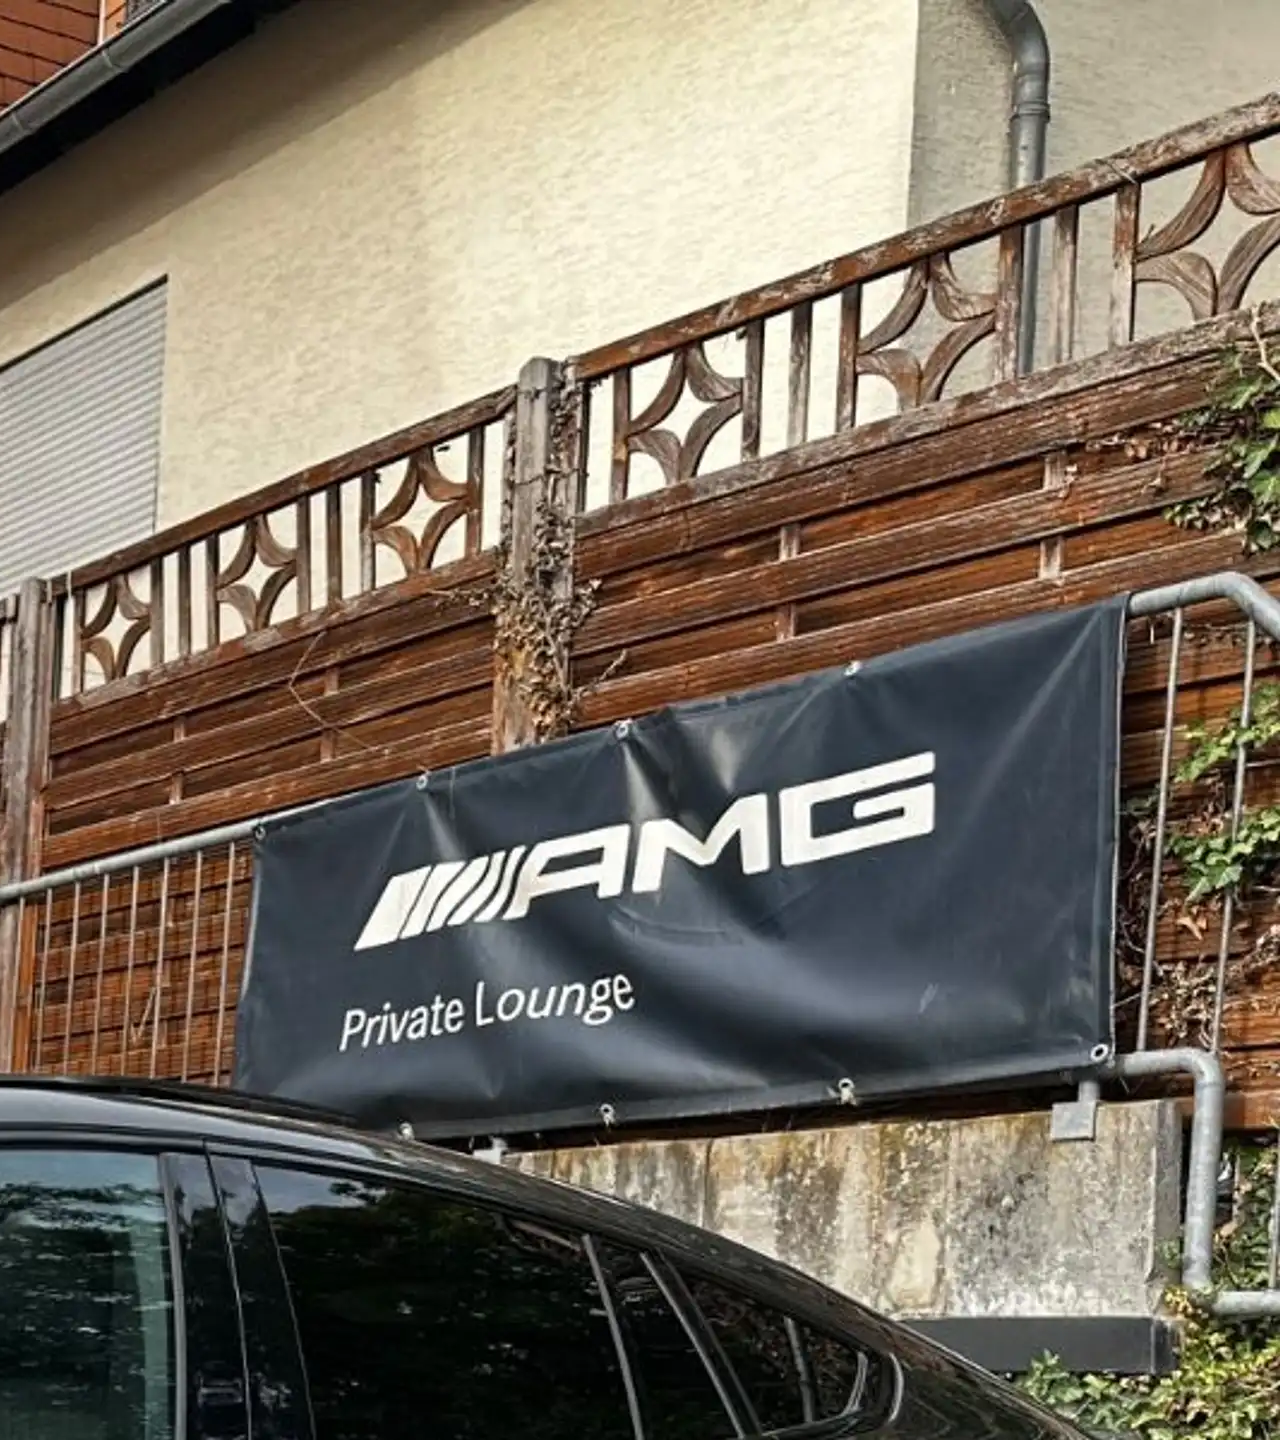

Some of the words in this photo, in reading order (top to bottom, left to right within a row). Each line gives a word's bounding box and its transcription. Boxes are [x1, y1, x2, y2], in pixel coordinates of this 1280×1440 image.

[502, 751, 936, 921] AMG
[339, 994, 466, 1052] Private
[474, 973, 636, 1026] Lounge
